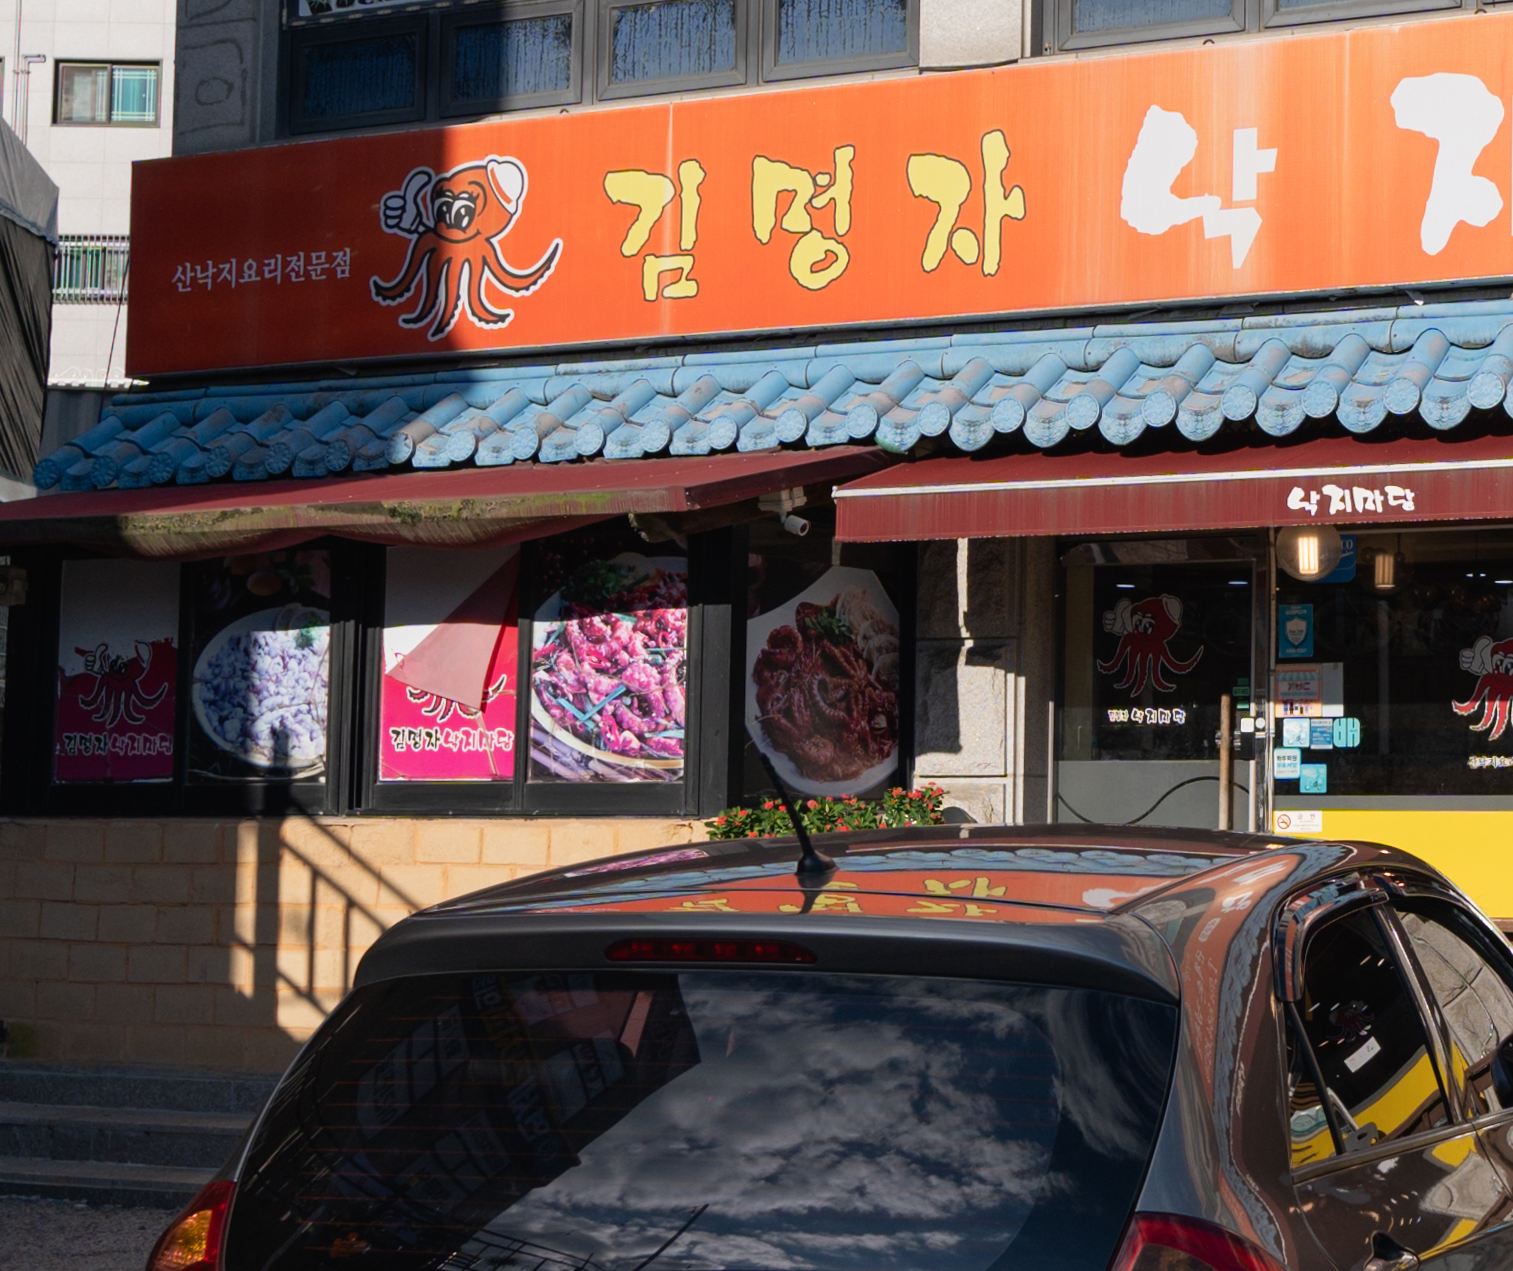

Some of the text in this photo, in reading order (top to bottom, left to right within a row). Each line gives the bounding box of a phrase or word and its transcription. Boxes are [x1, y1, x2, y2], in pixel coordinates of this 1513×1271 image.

[603, 129, 1025, 304] 김명자
[170, 248, 354, 293] 산낙지요리전문점
[1287, 483, 1416, 516] 낙지마당
[63, 732, 108, 756] 김명자
[389, 726, 440, 752] 김명자
